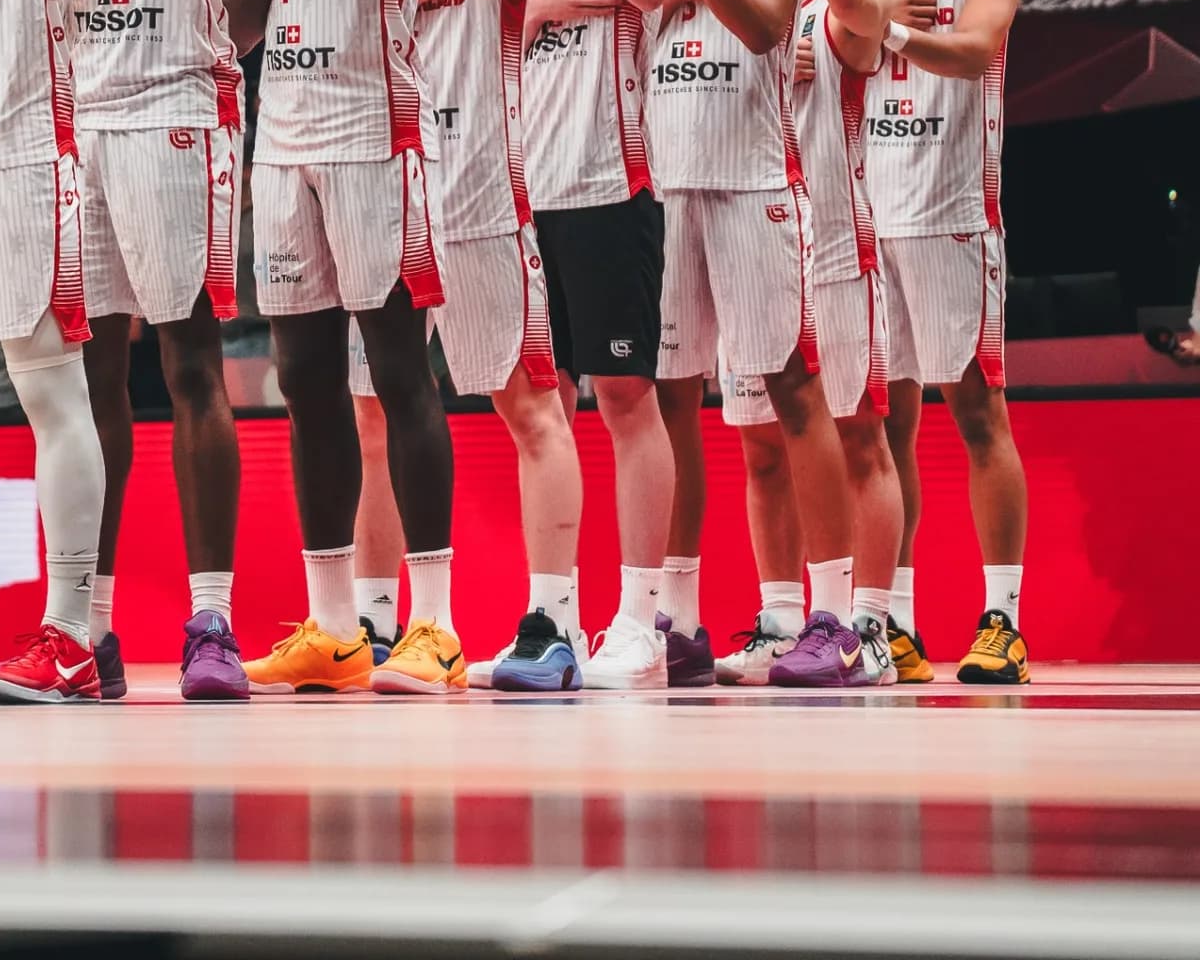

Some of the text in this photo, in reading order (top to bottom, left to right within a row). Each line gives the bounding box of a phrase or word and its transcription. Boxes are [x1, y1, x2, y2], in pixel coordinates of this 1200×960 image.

[74, 7, 164, 33] TISSOT
[266, 47, 336, 71] TISSOT
[652, 62, 740, 84] ISSOT
[866, 117, 945, 137] ISSOT
[270, 274, 303, 283] La Tour
[661, 341, 680, 350] Tour
